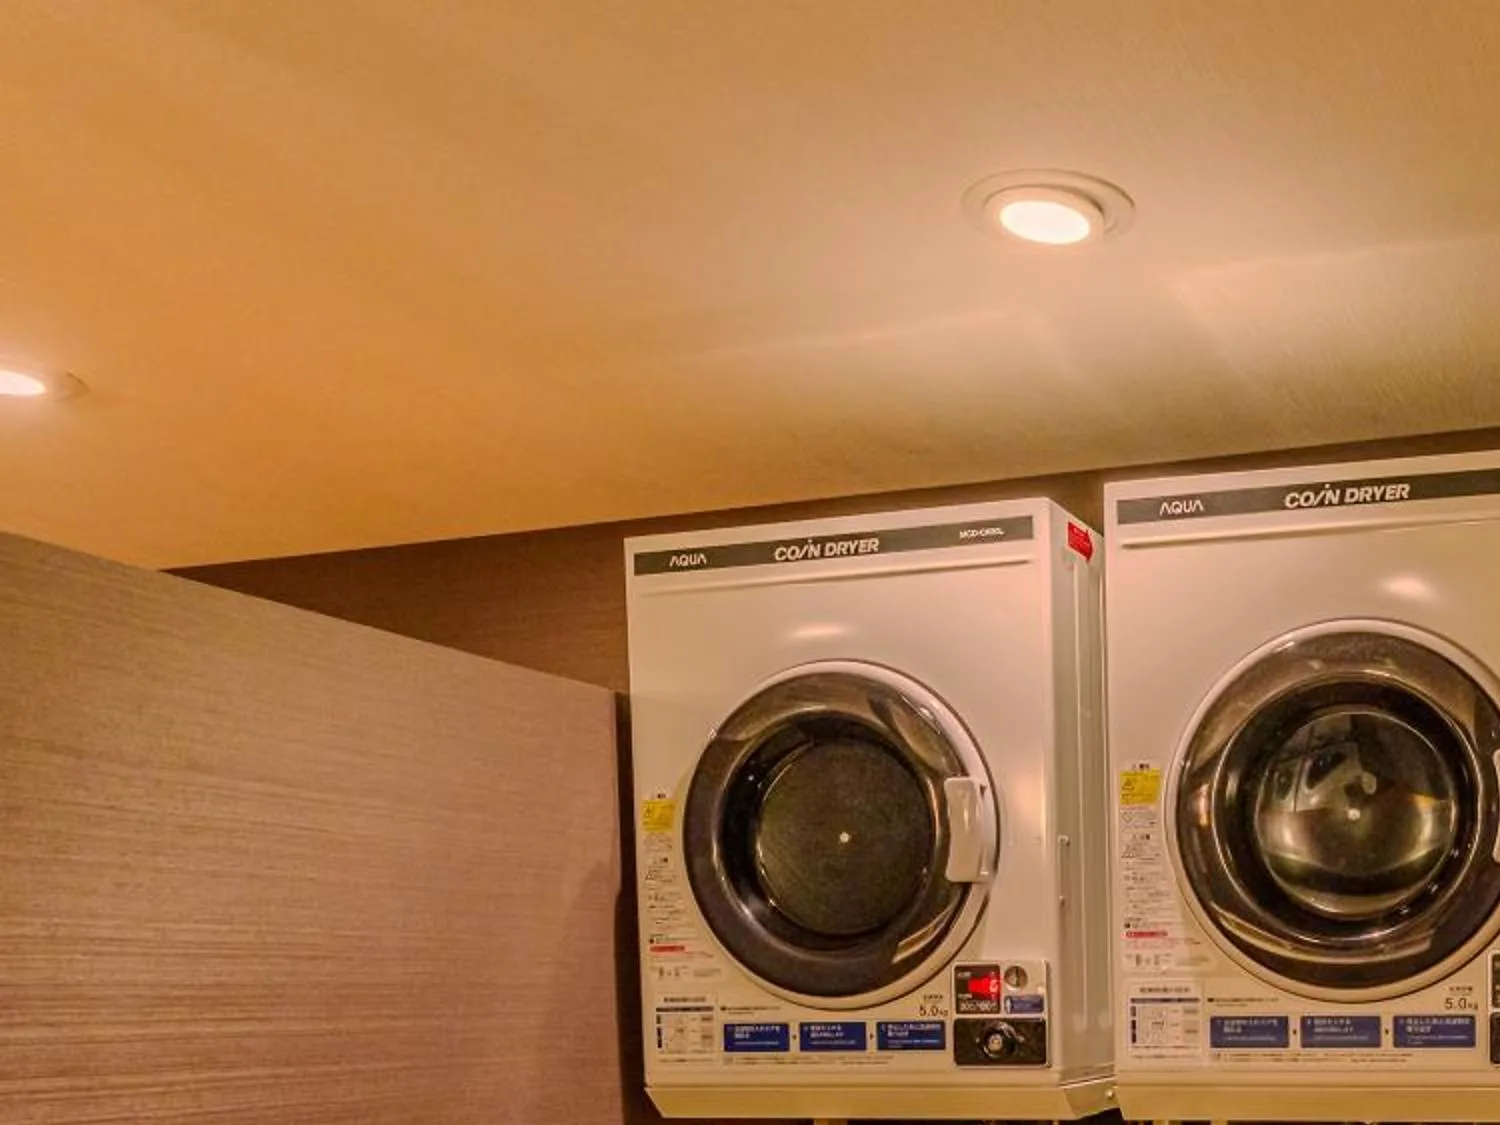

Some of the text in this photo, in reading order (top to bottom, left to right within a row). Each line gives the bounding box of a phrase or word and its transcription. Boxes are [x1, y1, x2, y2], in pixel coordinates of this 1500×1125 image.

[1344, 483, 1411, 505] DRYER
[1159, 499, 1205, 516] AQUA
[824, 538, 880, 558] DRYER
[669, 553, 707, 568] AQUA
